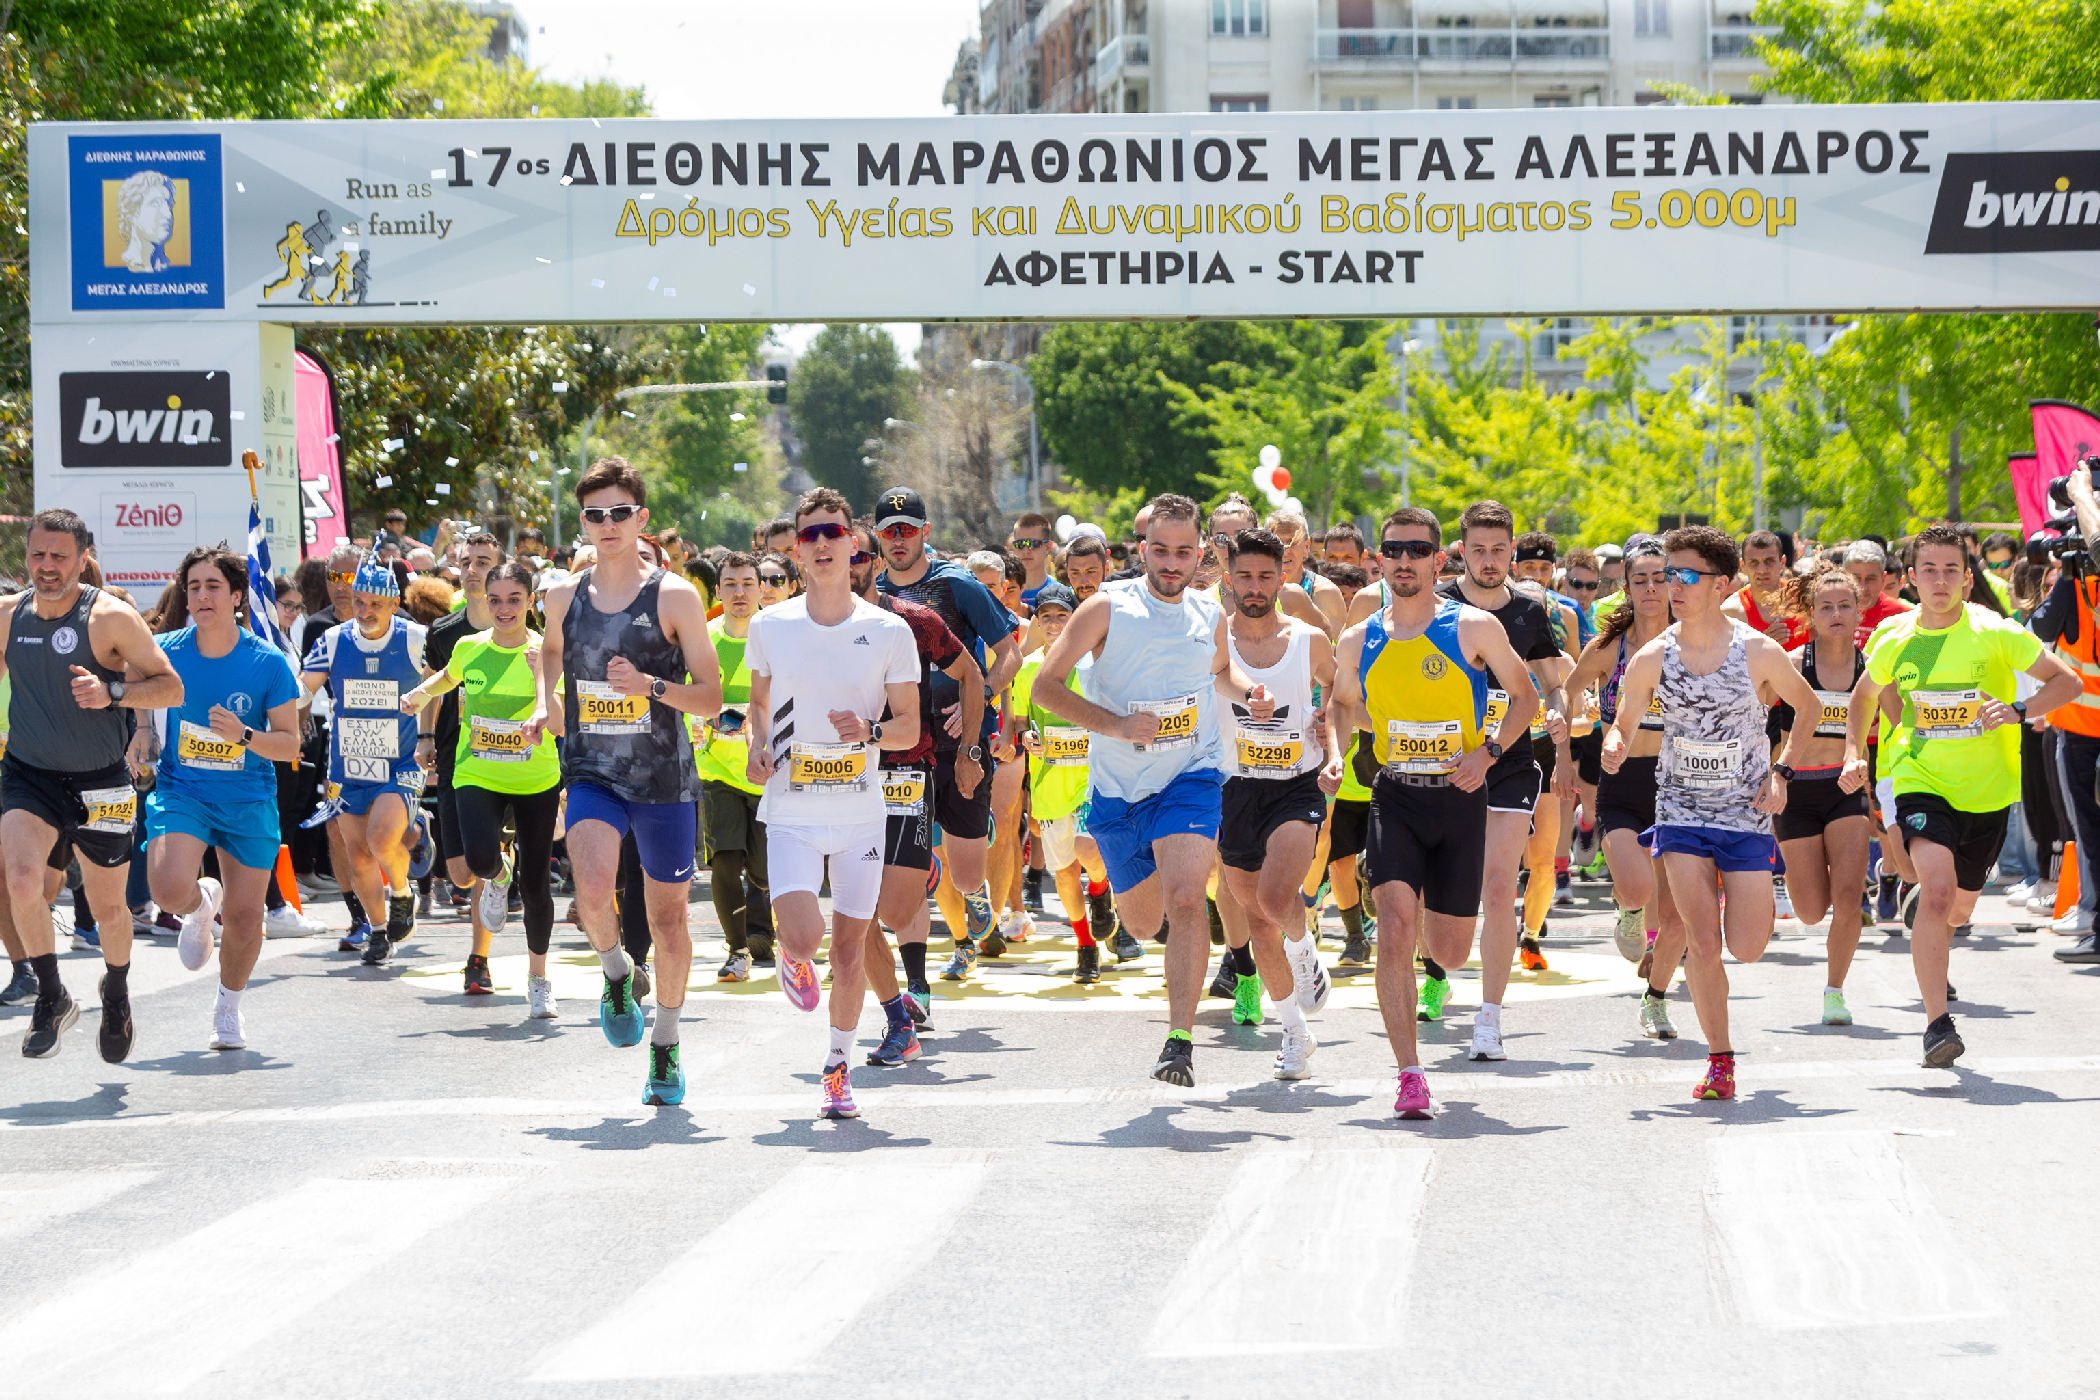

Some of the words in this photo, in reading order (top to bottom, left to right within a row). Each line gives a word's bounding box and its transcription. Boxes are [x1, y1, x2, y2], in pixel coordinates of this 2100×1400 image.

[85, 151, 133, 163] ΔΙΕΘΝΗΣ
[135, 150, 206, 162] ΜΑΡΑΘΩΝΙΟΣ
[561, 142, 831, 186] ΔΙΕΘΝΗΣ
[857, 138, 1268, 186] ΜΑΡΑΘΩΝΙΟΣ
[1298, 137, 1496, 181] ΜΕΓΑΣ
[1514, 130, 1930, 180] ΑΛΕΞΑΝΔΡΟΣ
[346, 178, 398, 199] Run
[406, 182, 432, 198] as
[1963, 176, 2100, 228] bwin
[615, 196, 791, 247] Δρόμος
[807, 198, 953, 247] Υγείας
[972, 205, 1037, 236] και
[1055, 193, 1301, 243] Δυναμικού
[1320, 192, 1592, 241] Βαδίσματος
[1610, 188, 1796, 237] 5.000μ
[368, 210, 453, 240] family
[984, 250, 1235, 286] ΑΦΕΤΗΡΙΑ
[1277, 250, 1424, 284] START
[87, 284, 126, 296] ΜΕΓΑΣ
[128, 283, 209, 295] ΑΛΕΞΑΝΔΡΟΣ
[78, 394, 214, 444] bwin
[588, 701, 634, 713] 50011
[1824, 706, 1848, 718] 003
[1923, 707, 1968, 720] 50372
[481, 732, 521, 745] 50040
[1400, 739, 1448, 752] 50012
[188, 739, 233, 755] 50307
[1248, 746, 1291, 760] 52298
[347, 759, 387, 778] ΟΧΙ
[804, 760, 853, 774] 50006
[1684, 756, 1727, 770] 10001
[883, 785, 912, 797] 010
